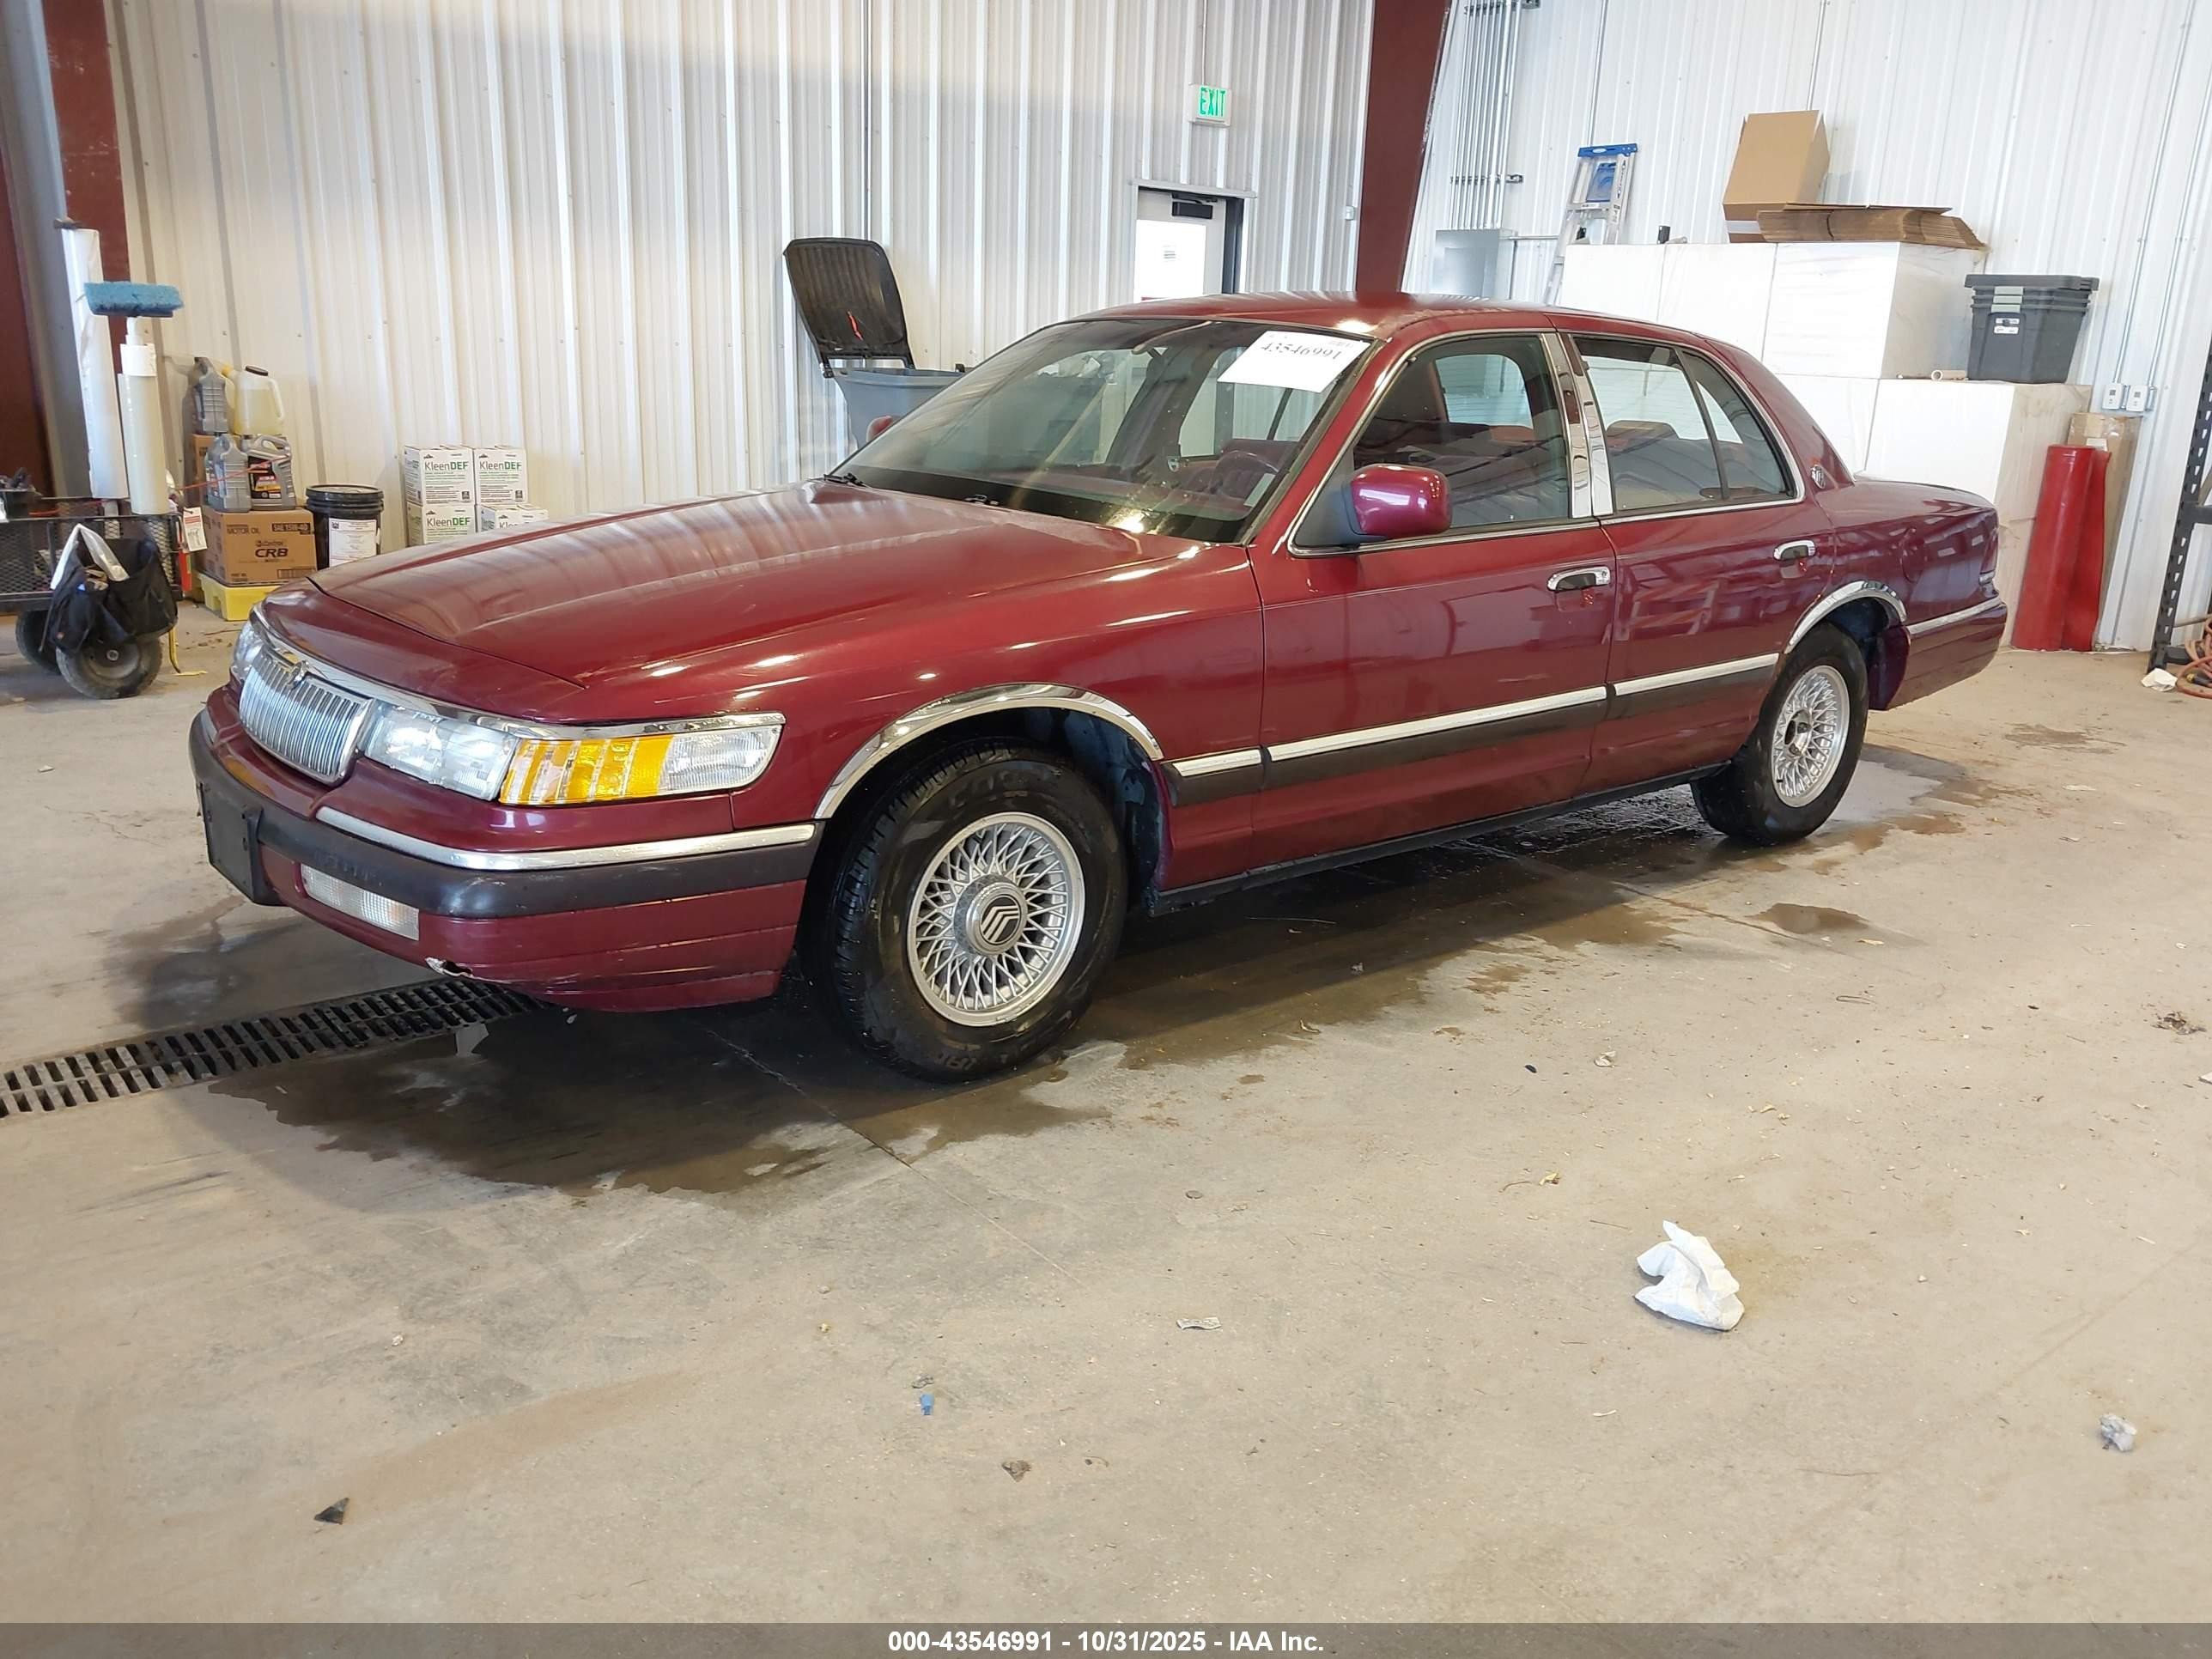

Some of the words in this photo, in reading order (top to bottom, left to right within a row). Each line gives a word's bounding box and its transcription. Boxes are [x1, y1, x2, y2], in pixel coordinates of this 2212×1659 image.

[1200, 87, 1226, 117] EXIT
[1261, 343, 1342, 360] 43546991
[424, 460, 470, 471] KleenDEF
[479, 460, 522, 471] KleenDEF
[426, 517, 471, 527] KleenDEF
[255, 548, 289, 558] CRB
